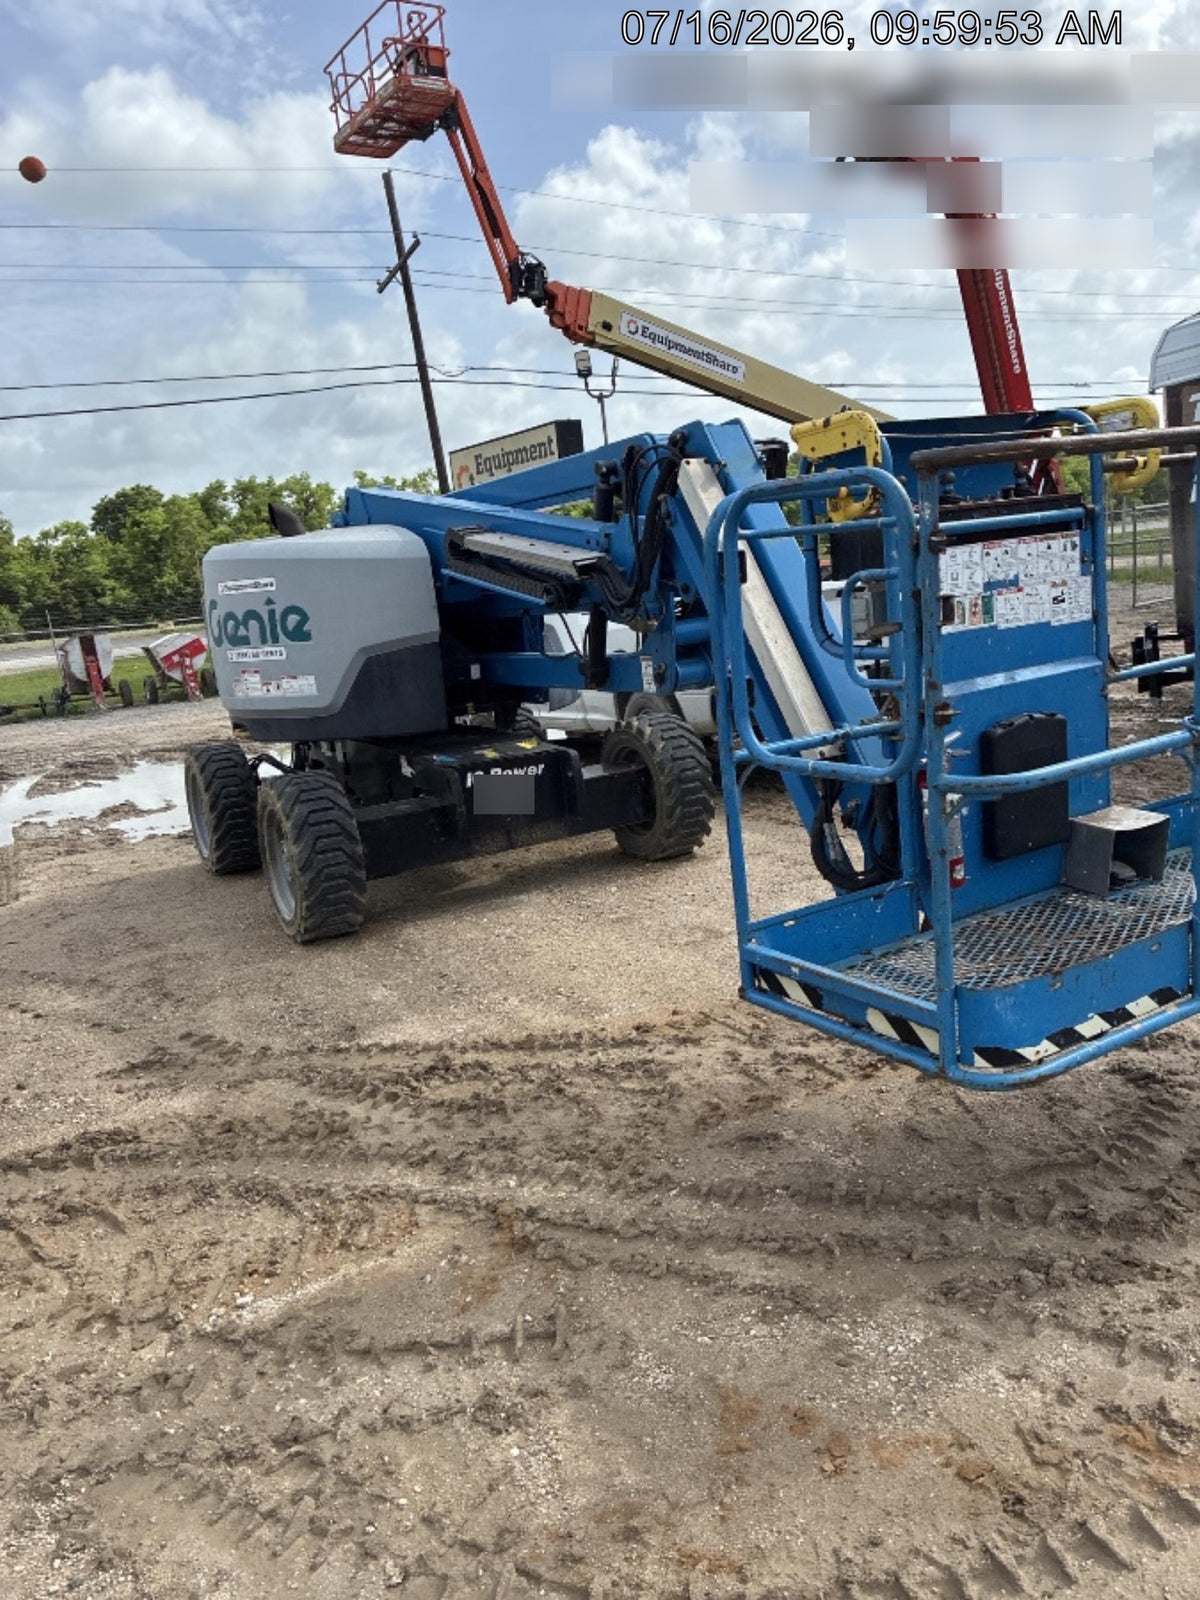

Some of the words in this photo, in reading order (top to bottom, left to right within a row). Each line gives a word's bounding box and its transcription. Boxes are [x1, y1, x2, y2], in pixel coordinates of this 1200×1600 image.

[640, 324, 739, 375] EquipmentShare
[474, 436, 555, 477] Equipment
[209, 597, 312, 647] Genie
